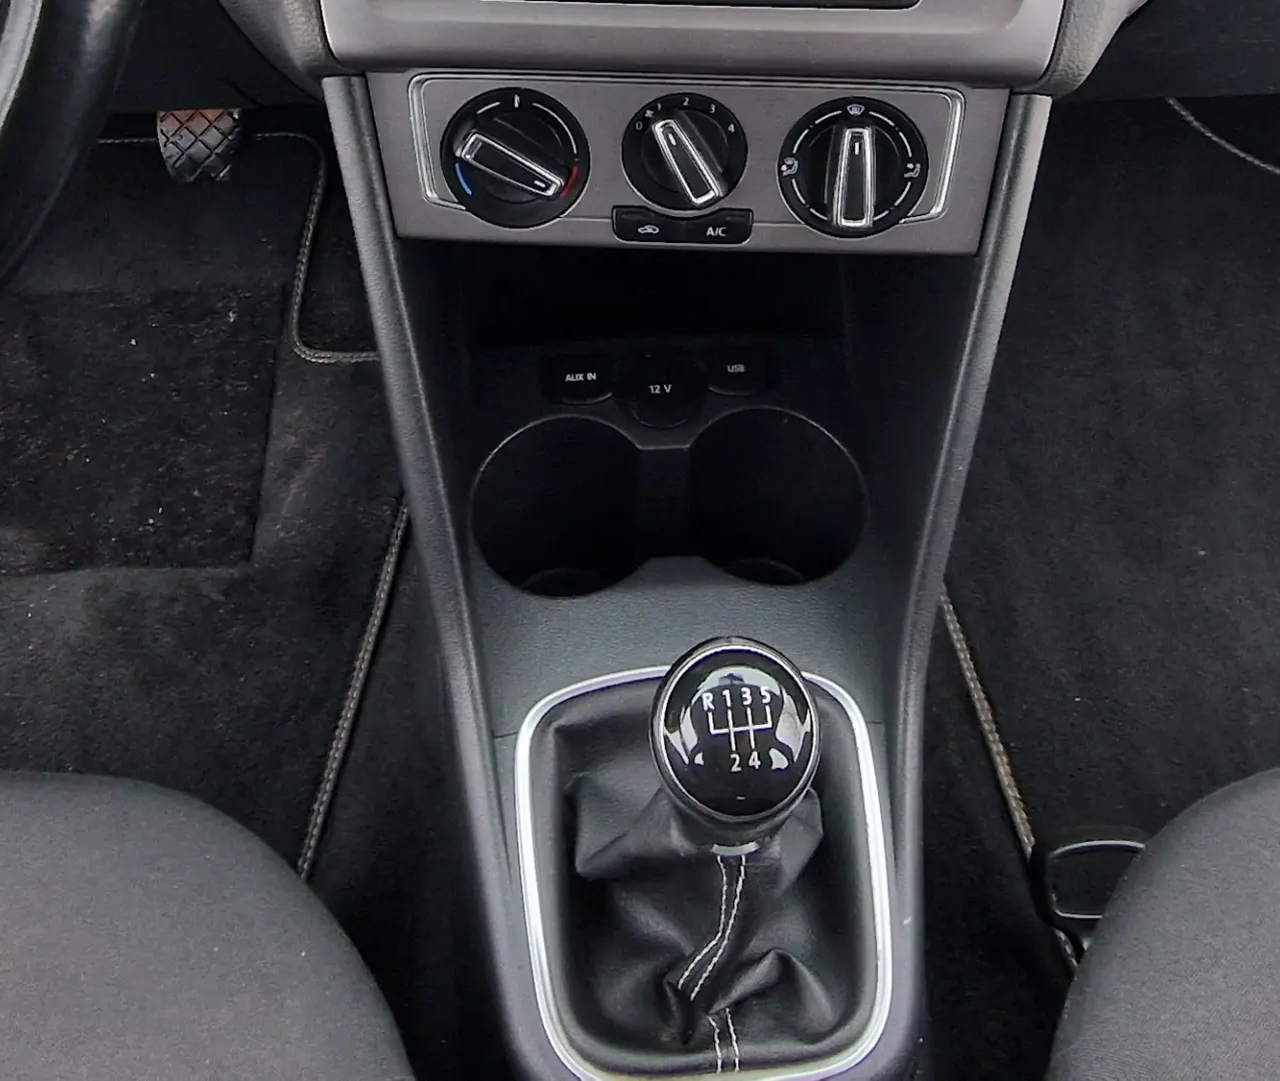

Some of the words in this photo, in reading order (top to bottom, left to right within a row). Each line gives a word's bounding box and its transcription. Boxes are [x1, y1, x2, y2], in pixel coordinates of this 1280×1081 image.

[682, 97, 690, 106] 2
[710, 104, 716, 113] 3
[635, 121, 643, 130] 0
[727, 123, 735, 133] 4
[705, 226, 727, 237] A/C
[726, 365, 745, 373] USB
[565, 373, 584, 382] AUX
[587, 372, 597, 381] IN
[649, 384, 660, 394] 12
[664, 384, 672, 393] V
[702, 692, 714, 711] R
[722, 689, 732, 707] 1
[740, 687, 752, 705] 3
[760, 686, 771, 703] 5
[730, 753, 742, 772] 2
[748, 750, 761, 769] 4
